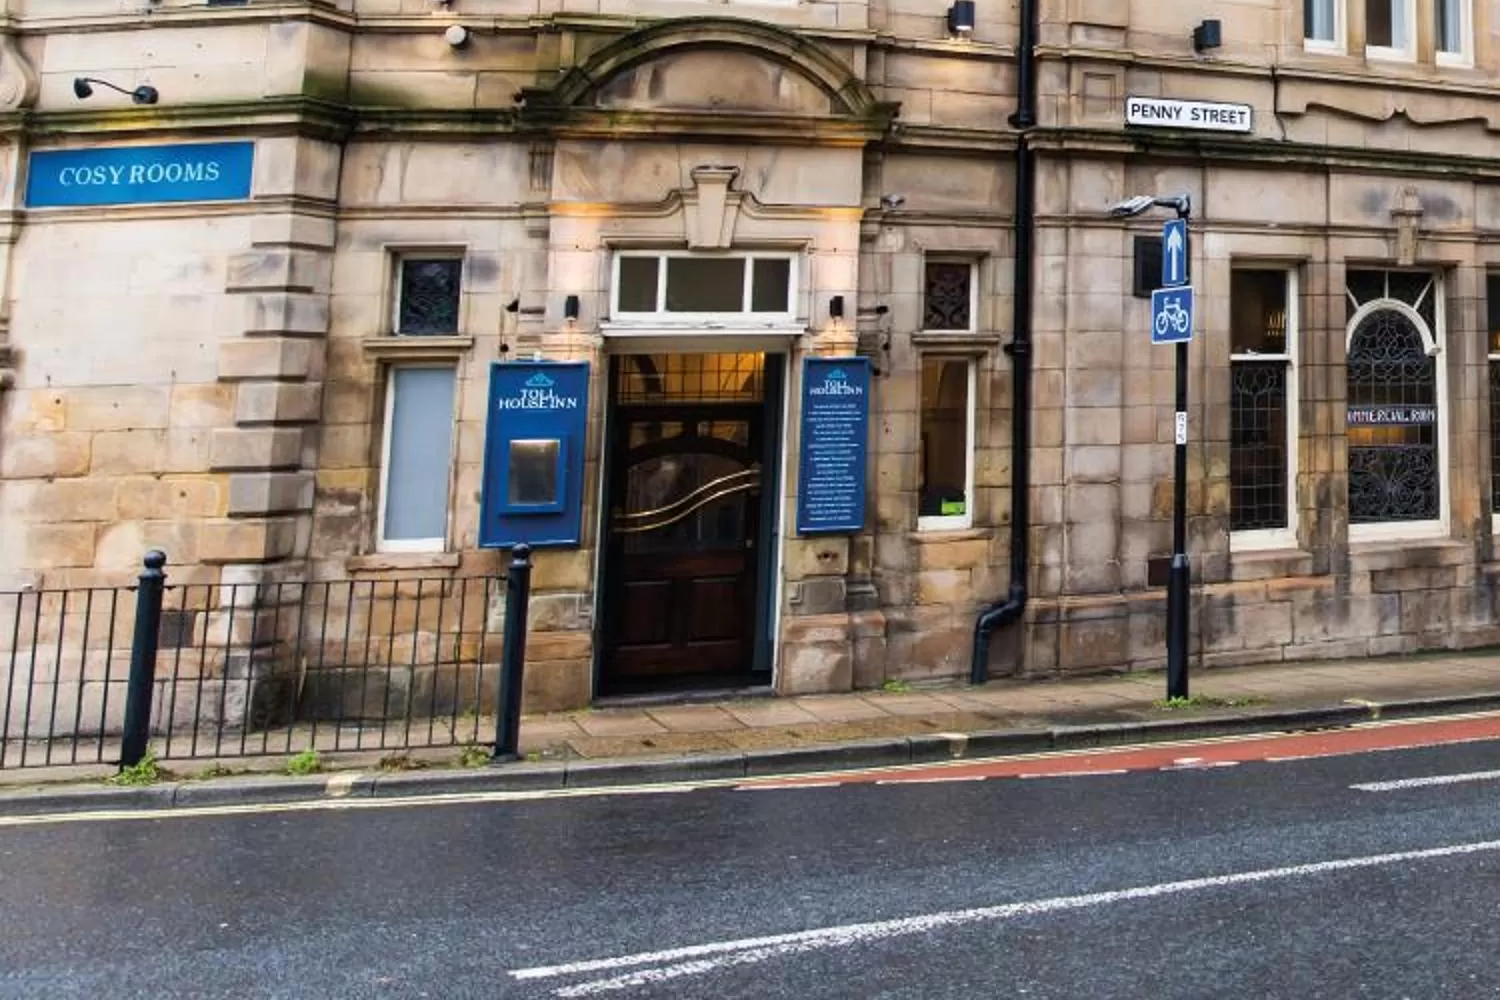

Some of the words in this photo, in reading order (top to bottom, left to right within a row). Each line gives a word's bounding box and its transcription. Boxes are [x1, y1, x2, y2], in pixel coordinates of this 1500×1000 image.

[1131, 103, 1183, 119] PENNY
[1190, 107, 1247, 124] STREET
[59, 165, 125, 186] COSY
[128, 161, 220, 185] ROOMS
[520, 388, 558, 401] TOLL
[499, 398, 548, 410] HOUSE
[549, 397, 577, 409] INN
[1347, 408, 1409, 423] OMMERCIAL
